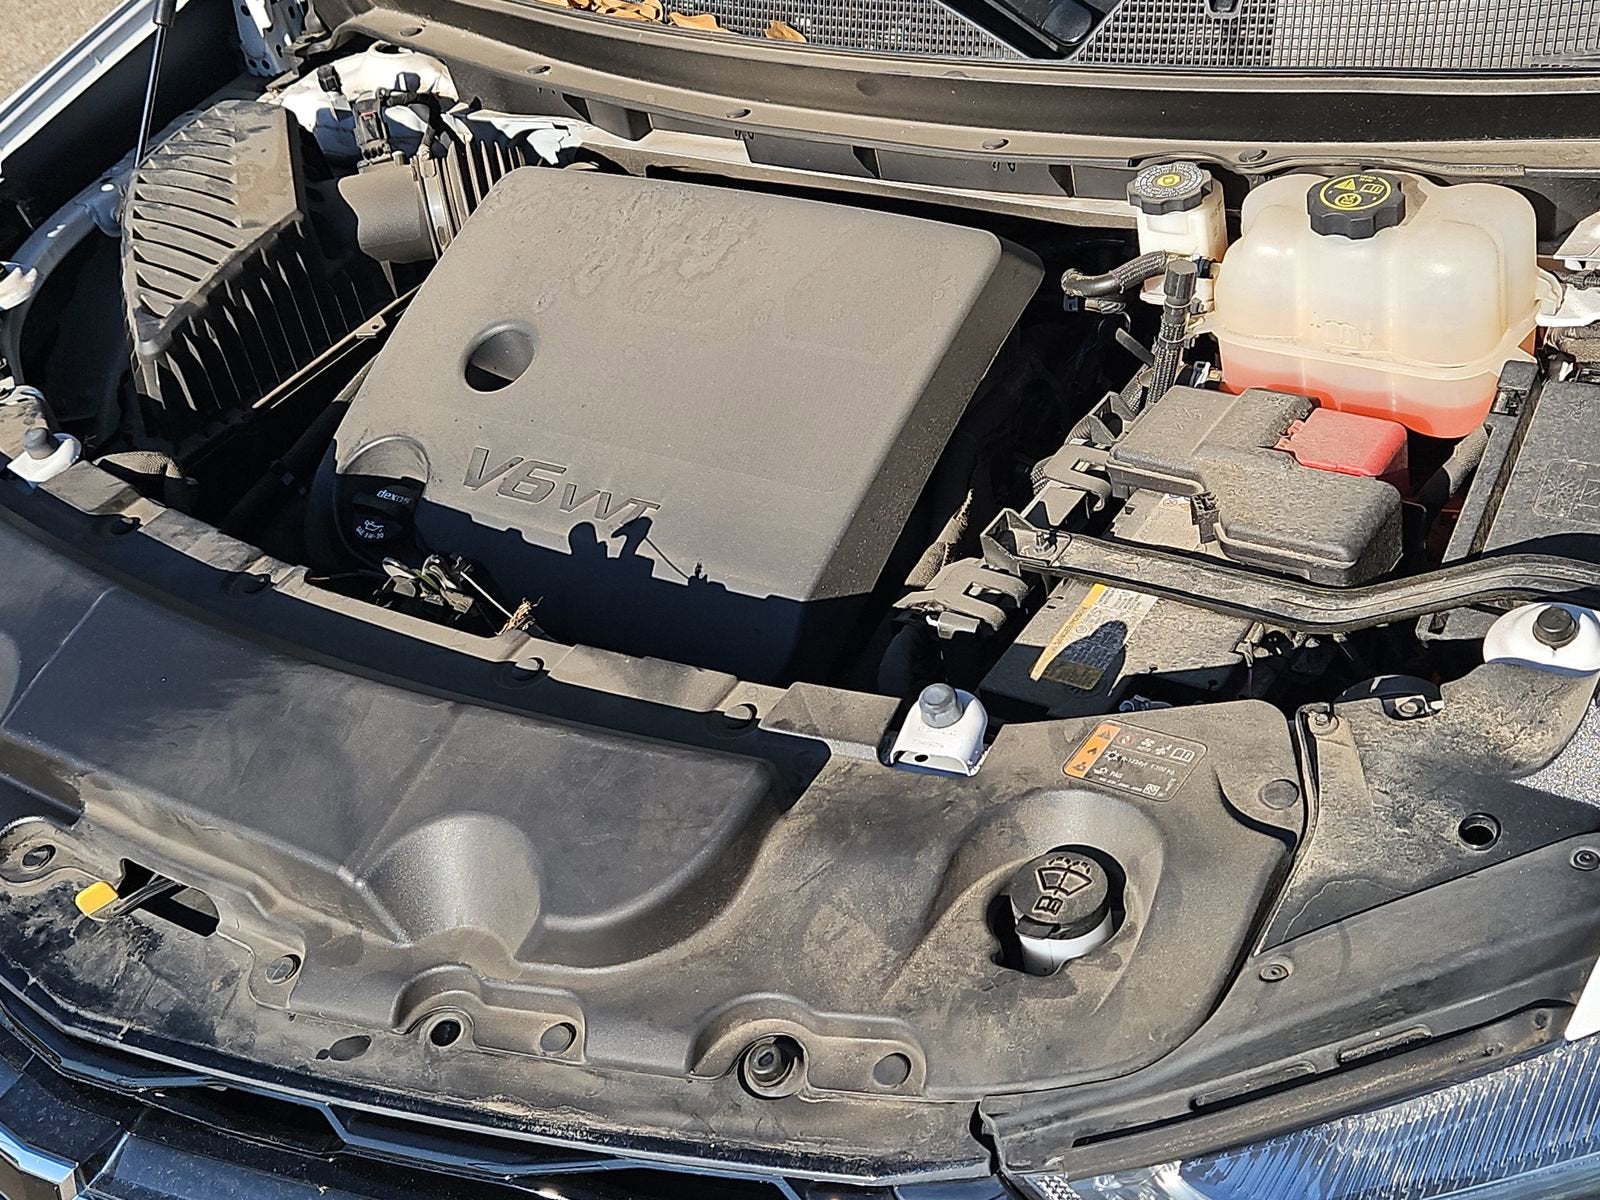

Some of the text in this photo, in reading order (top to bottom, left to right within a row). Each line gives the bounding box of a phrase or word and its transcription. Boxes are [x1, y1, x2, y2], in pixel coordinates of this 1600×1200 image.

[376, 489, 413, 505] dexos
[463, 446, 661, 524] V6 VVT
